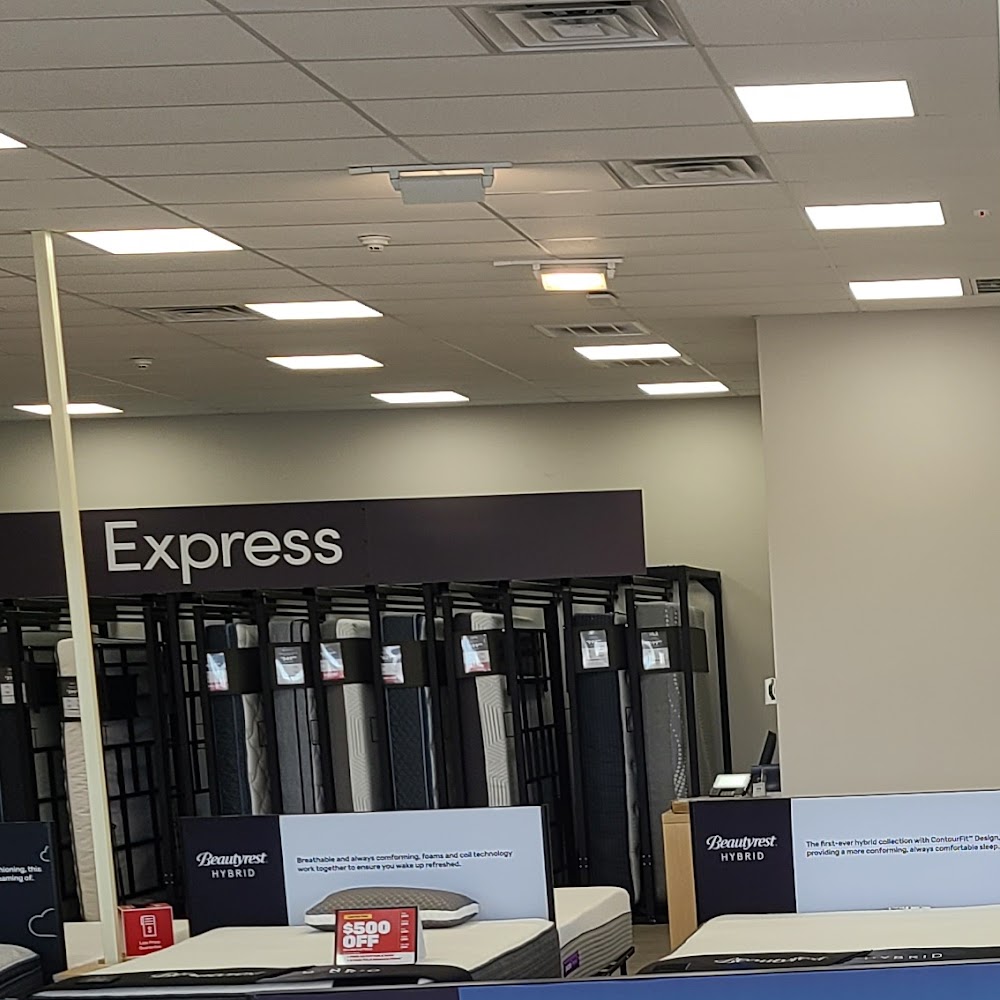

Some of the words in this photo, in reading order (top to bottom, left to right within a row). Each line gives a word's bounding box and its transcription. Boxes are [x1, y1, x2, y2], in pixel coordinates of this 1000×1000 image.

[104, 520, 343, 584] Express
[706, 834, 777, 850] Beautyrest
[854, 839, 877, 847] hybrid
[720, 852, 765, 862] HYBRID
[806, 849, 840, 857] providing
[196, 851, 268, 868] Beautyrest
[211, 868, 256, 878] HYBRID
[316, 864, 346, 872] together
[342, 920, 391, 935] $500
[342, 934, 380, 948] OFF
